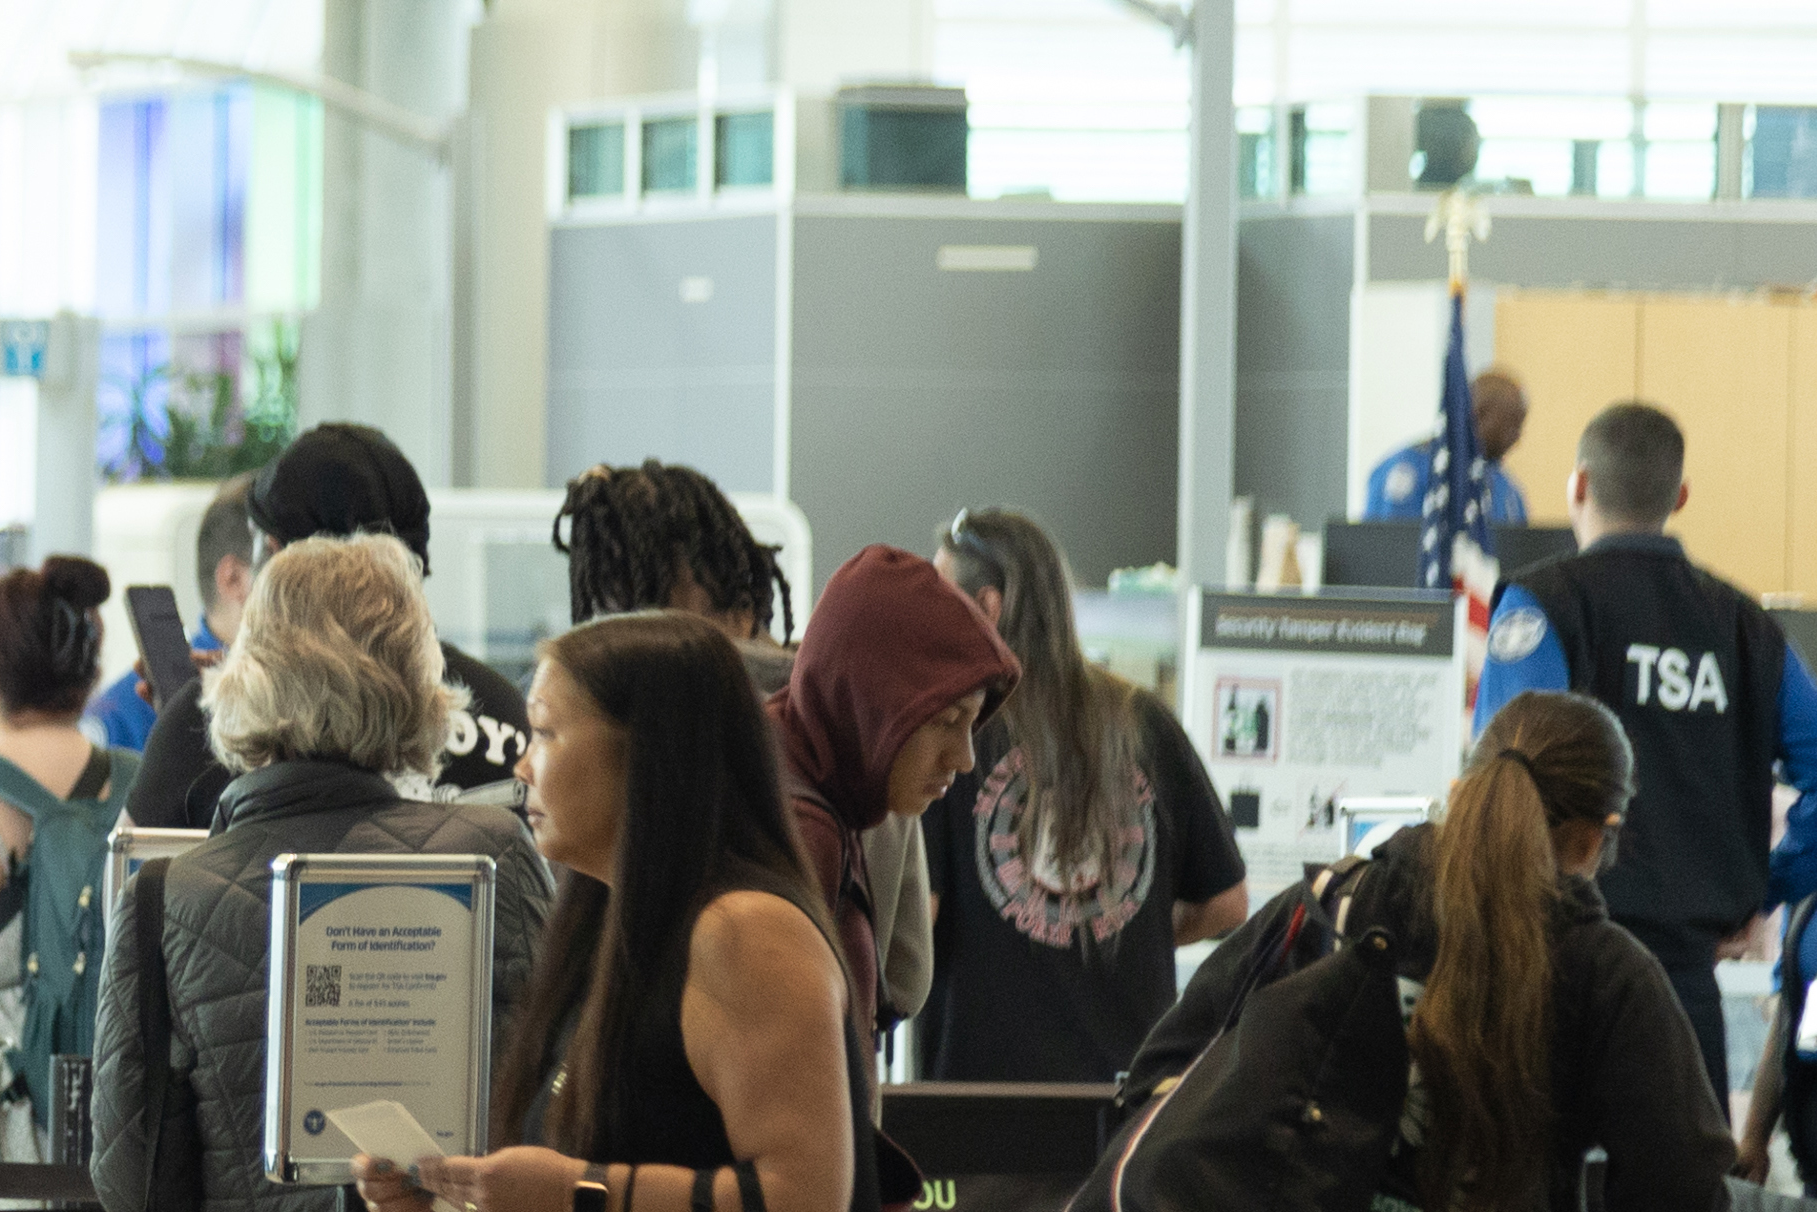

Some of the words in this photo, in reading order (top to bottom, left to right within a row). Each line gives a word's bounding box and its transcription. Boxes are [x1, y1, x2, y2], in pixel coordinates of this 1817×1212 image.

[1626, 643, 1729, 714] TSA
[326, 926, 351, 938] Don't
[352, 926, 377, 938] Have
[378, 929, 390, 938] an
[392, 926, 442, 940] Acceptable
[332, 940, 357, 951] Form
[358, 940, 368, 951] of
[369, 940, 436, 951] Identification?
